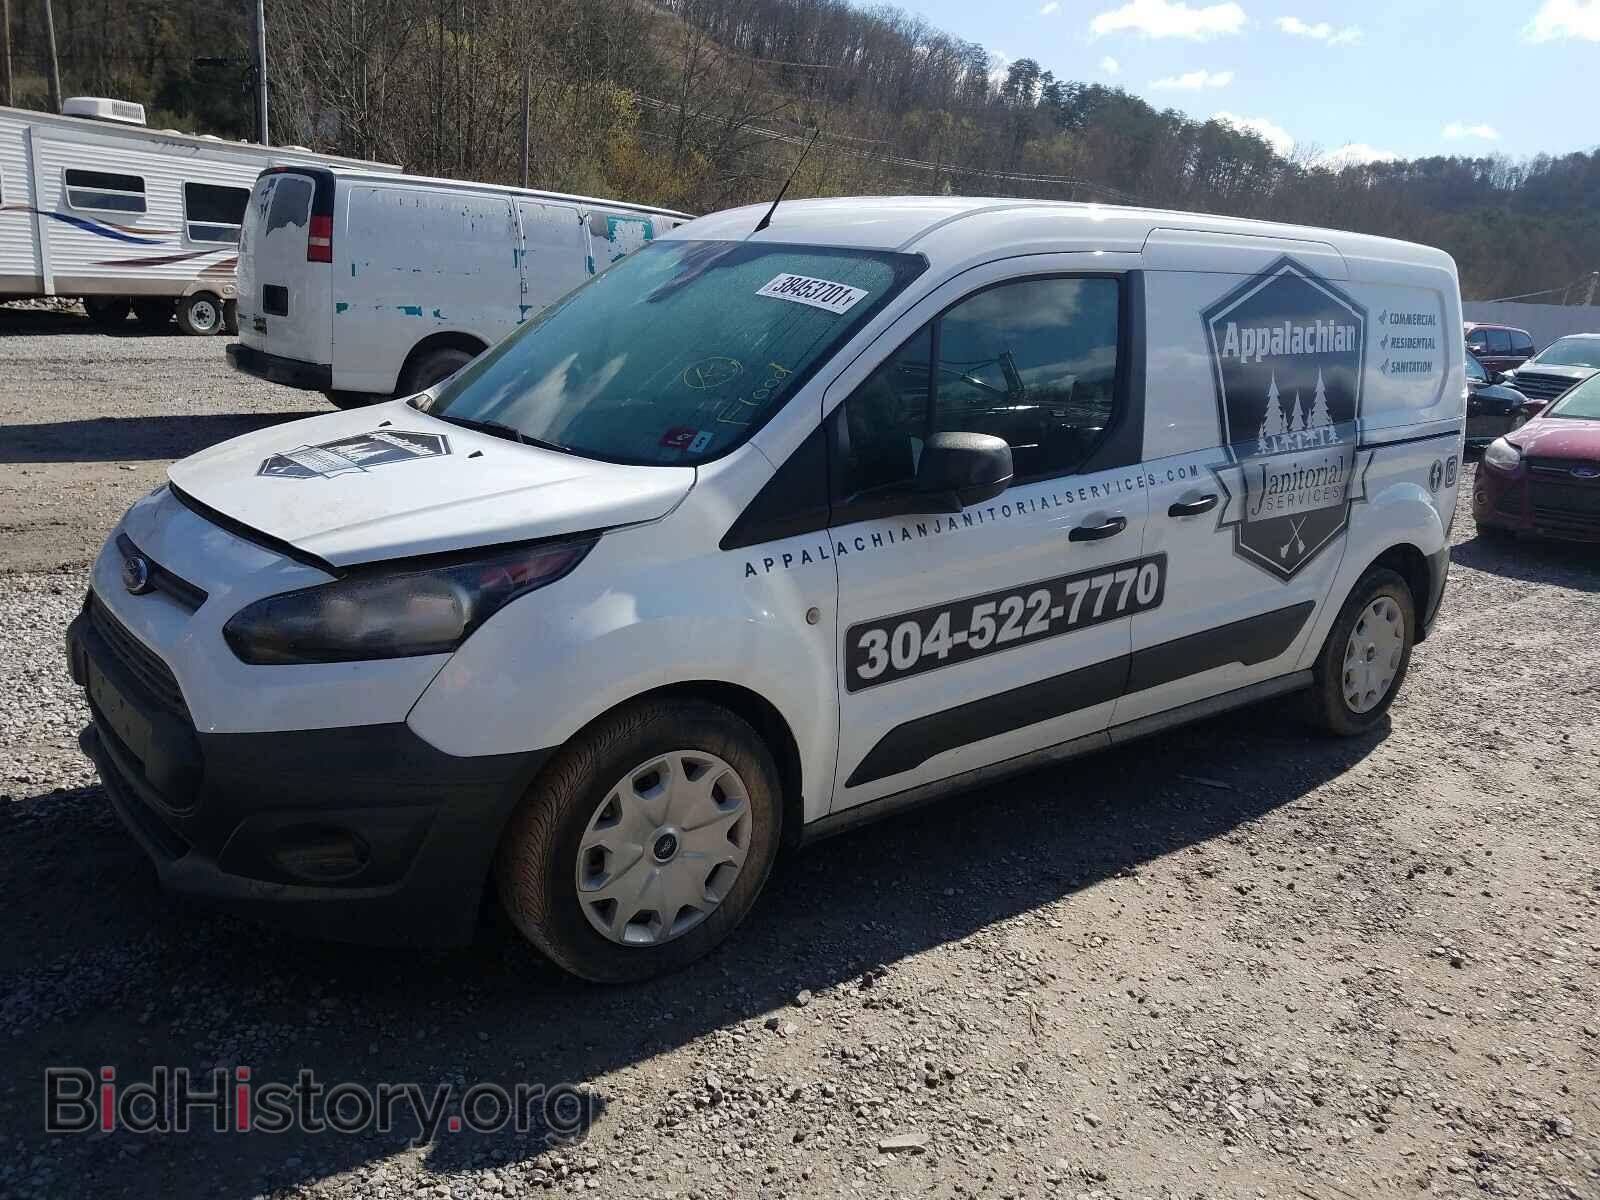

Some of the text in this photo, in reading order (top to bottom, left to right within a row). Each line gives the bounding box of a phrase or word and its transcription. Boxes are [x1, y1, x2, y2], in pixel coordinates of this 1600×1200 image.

[1390, 312, 1436, 326] COMMERCIAL
[1222, 319, 1356, 364] Appalachian
[1391, 337, 1436, 350] RESIDENTIAL
[1391, 361, 1433, 373] SANITATION
[1251, 456, 1345, 516] Janitorial
[1266, 488, 1341, 511] SERVICES
[744, 464, 1200, 578] APPALACHIANJANITORIALSERVICES.COM
[856, 563, 1159, 680] 304-522-7770
